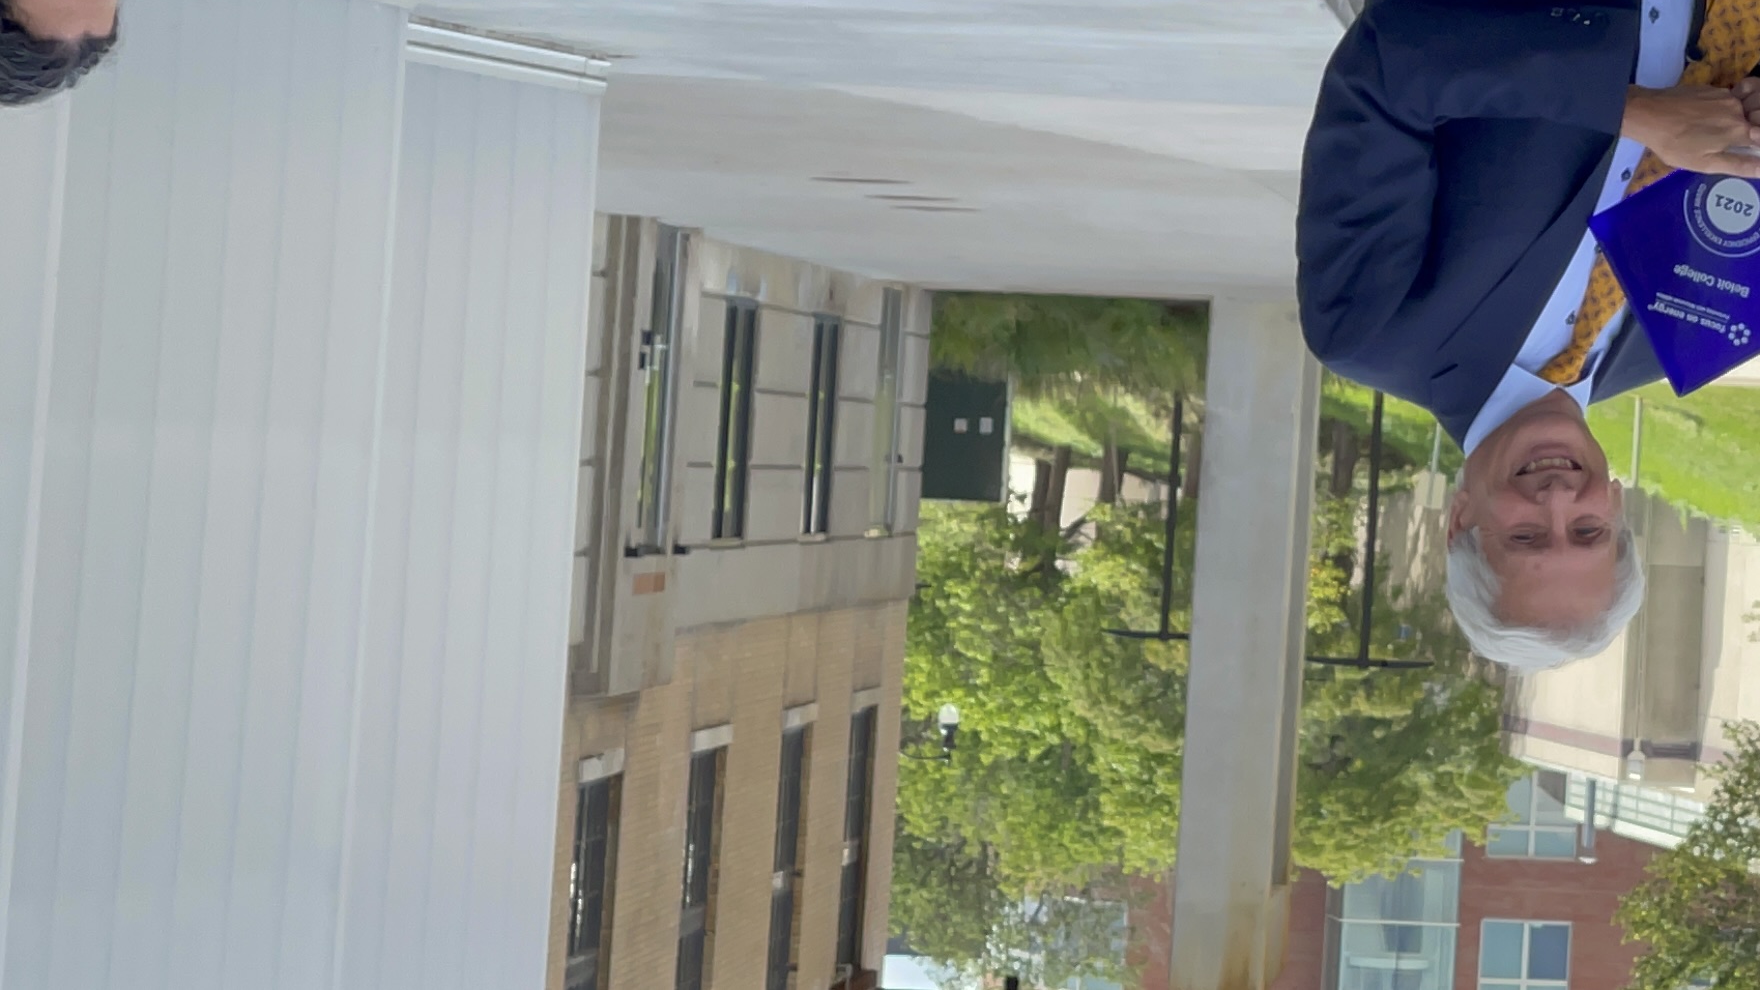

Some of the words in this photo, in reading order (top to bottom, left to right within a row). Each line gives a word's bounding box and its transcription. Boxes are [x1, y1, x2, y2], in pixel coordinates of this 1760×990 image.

[1715, 194, 1754, 216] 2021
[1673, 264, 1716, 286] College
[1717, 278, 1750, 298] Beloit
[1687, 314, 1698, 323] on
[1700, 318, 1726, 333] focus
